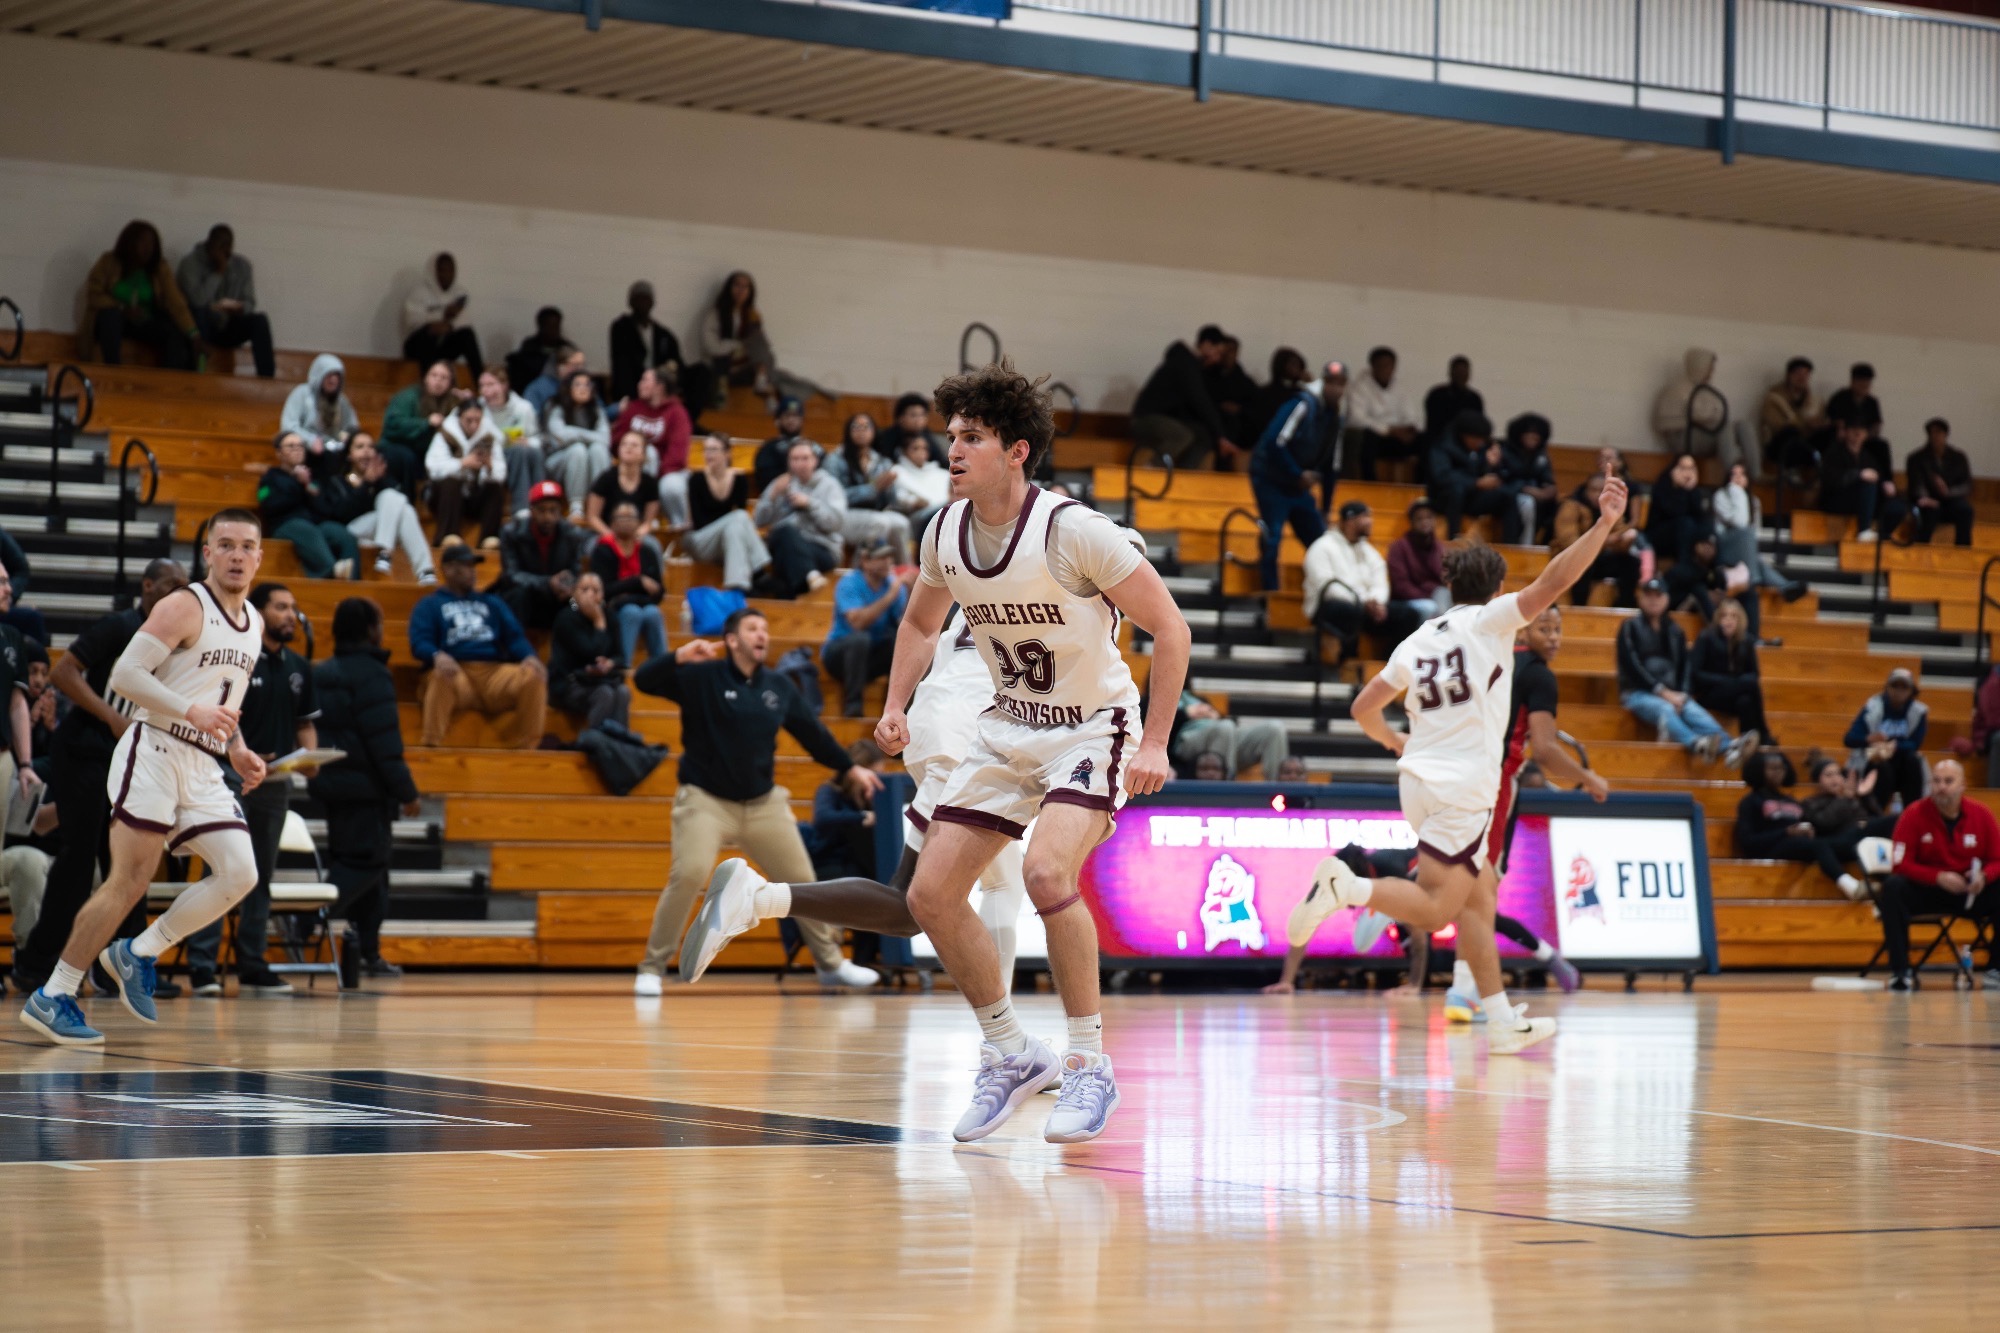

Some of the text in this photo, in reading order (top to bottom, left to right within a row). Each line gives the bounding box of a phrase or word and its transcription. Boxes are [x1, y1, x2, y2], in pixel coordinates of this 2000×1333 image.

[962, 602, 1066, 628] FAIRLEIGH
[216, 675, 234, 706] 1
[1413, 644, 1473, 712] 33
[1616, 861, 1685, 899] FDU
